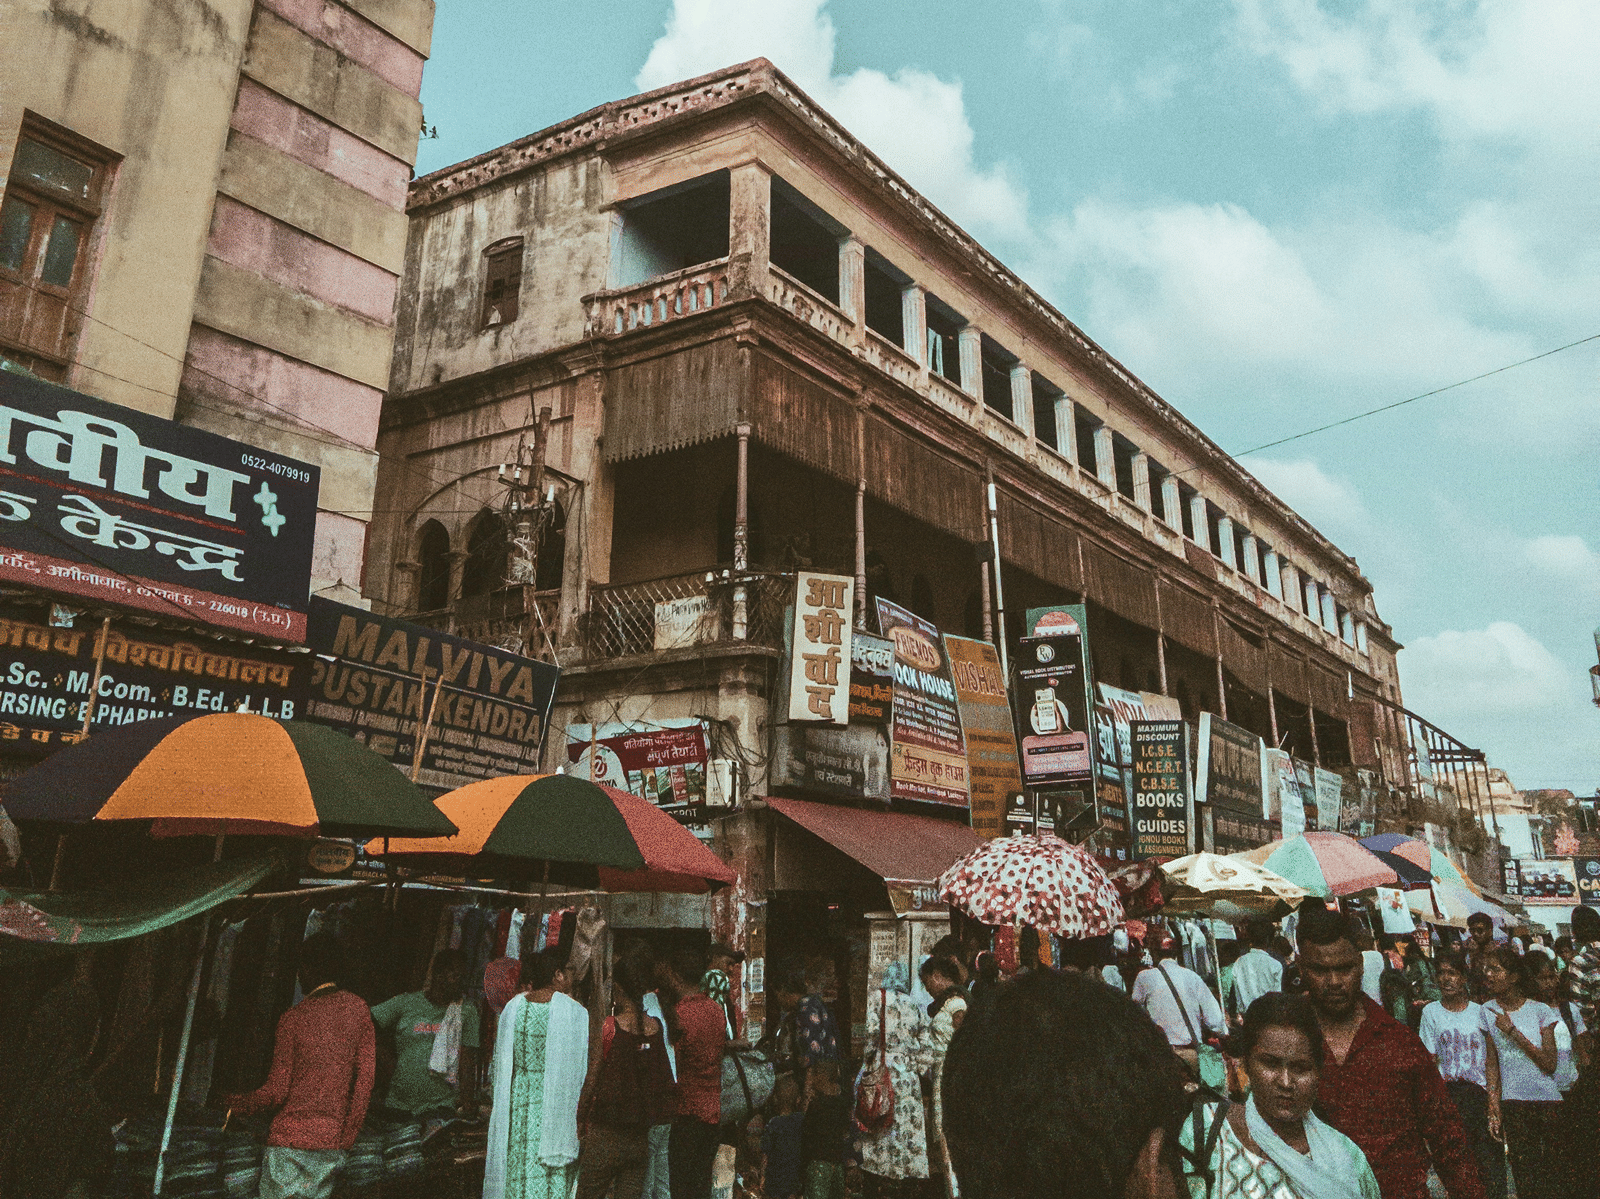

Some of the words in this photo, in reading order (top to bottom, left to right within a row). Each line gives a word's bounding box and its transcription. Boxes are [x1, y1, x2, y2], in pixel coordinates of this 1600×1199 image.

[0, 404, 251, 522] वीय
[241, 453, 311, 484] 0522-4079919
[209, 600, 249, 619] 226018
[332, 614, 535, 703] MALVIYA
[894, 630, 936, 667] FRIENDS
[66, 670, 156, 704] M.Com.
[172, 685, 229, 713] B.Ed.
[894, 661, 920, 690] OOK
[918, 670, 954, 703] HOUSE
[951, 660, 1006, 697] VISHAL
[434, 690, 541, 745] KENDRA
[1137, 723, 1179, 733] MAXIMUM
[1136, 733, 1181, 742] DISCOUNT
[1136, 793, 1185, 808] BOOKS
[1157, 808, 1165, 818] &
[1137, 819, 1186, 834] GUIDES
[1162, 836, 1186, 845] BOOKS
